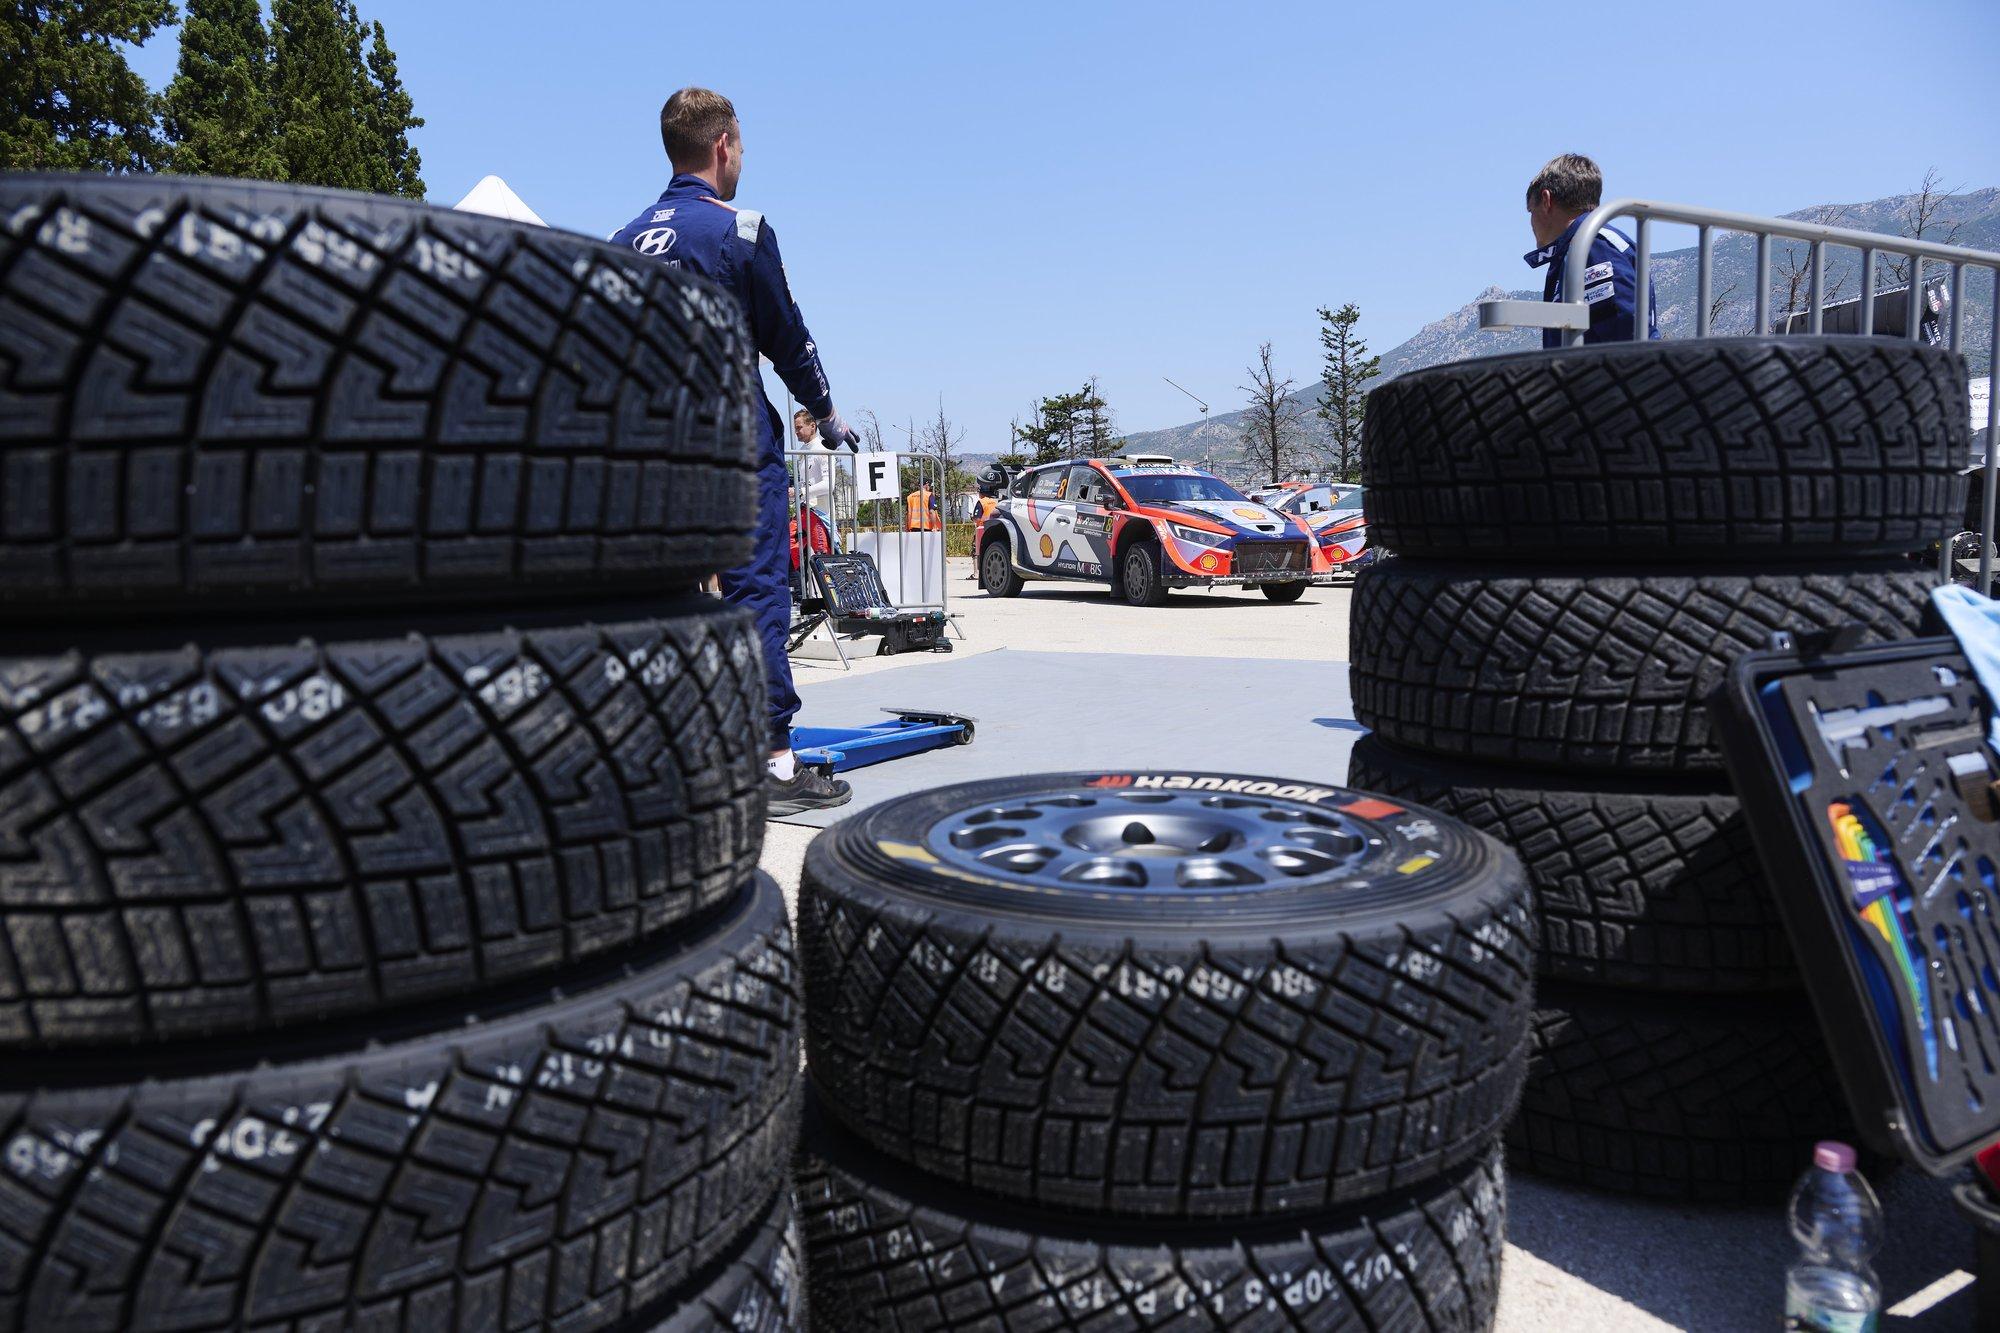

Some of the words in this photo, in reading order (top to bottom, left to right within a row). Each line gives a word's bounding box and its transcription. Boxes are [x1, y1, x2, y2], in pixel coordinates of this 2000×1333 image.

[652, 209, 675, 221] OMP
[868, 461, 886, 492] F
[1057, 478, 1068, 498] 8
[1106, 517, 1113, 532] 8
[1077, 560, 1102, 576] MOBIS
